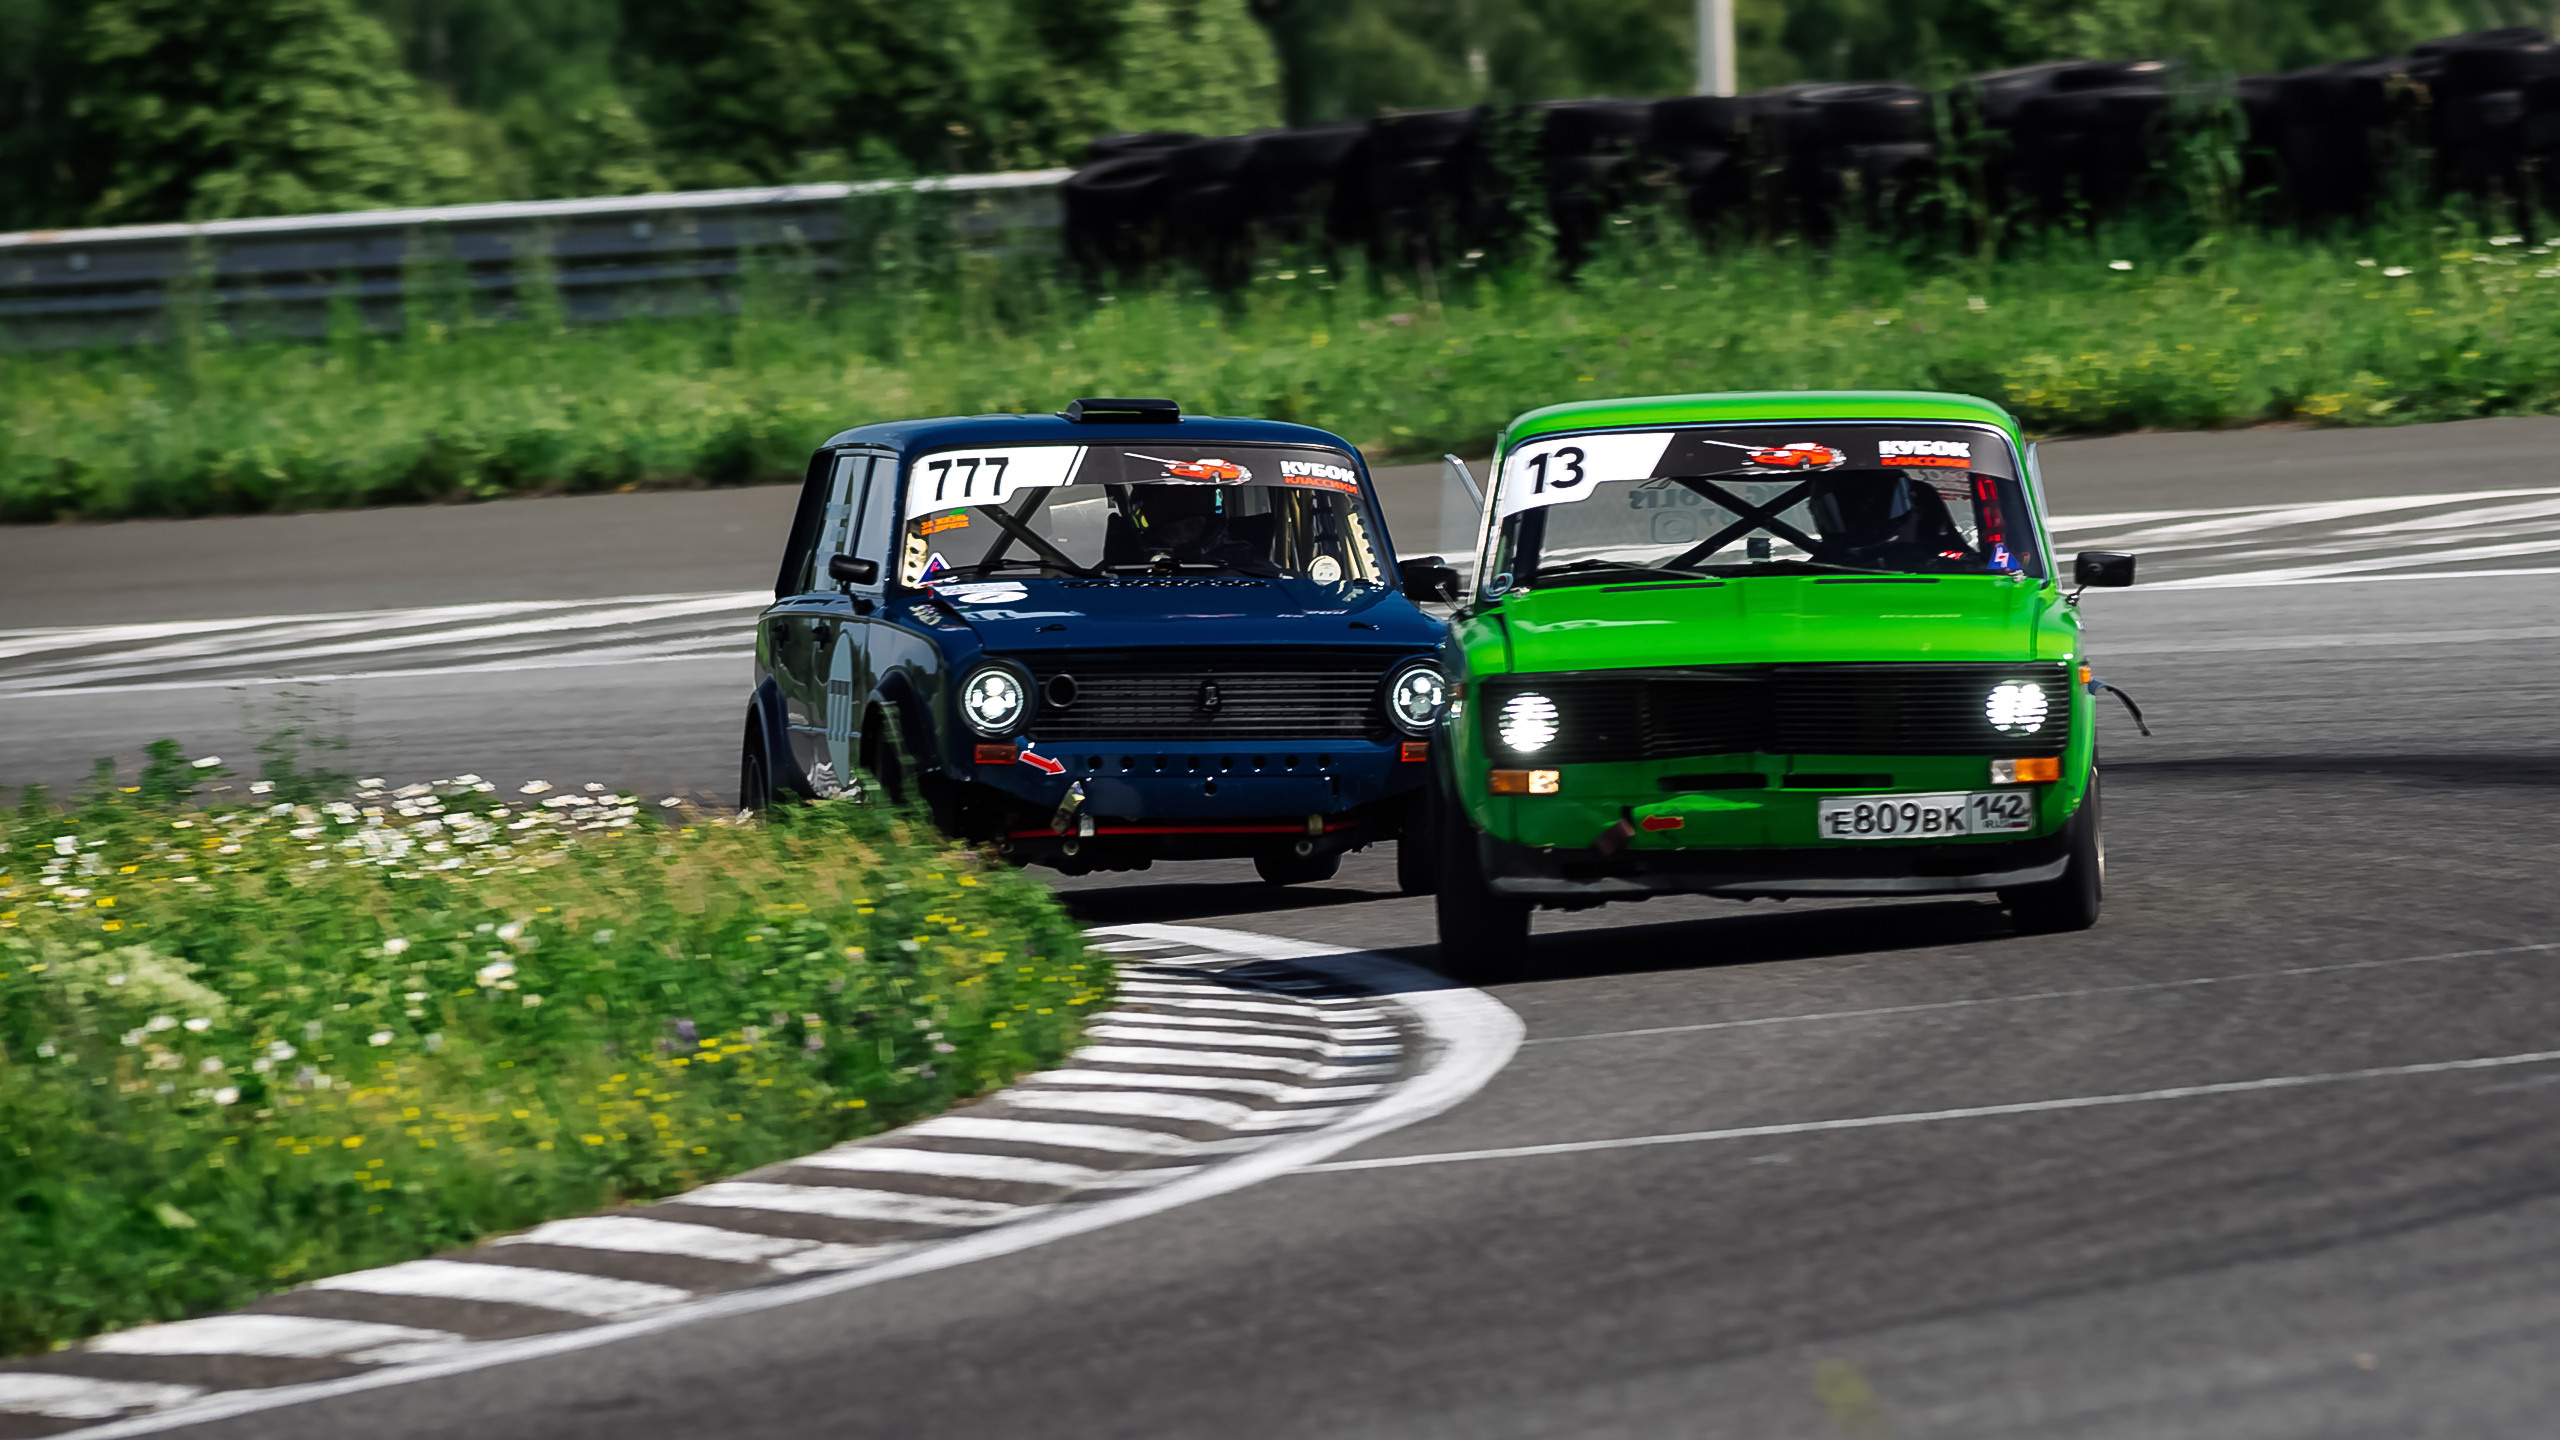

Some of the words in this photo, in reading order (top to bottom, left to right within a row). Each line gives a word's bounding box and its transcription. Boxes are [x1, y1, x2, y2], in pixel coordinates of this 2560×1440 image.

[1879, 441, 1971, 457] КУБОК
[928, 457, 1009, 501] 777
[1280, 461, 1357, 485] КУБОК
[1284, 476, 1359, 494] КЛАССИКИ
[1528, 446, 1584, 494] 13
[1831, 801, 1965, 834] Е809ВК
[1973, 794, 2024, 820] 142
